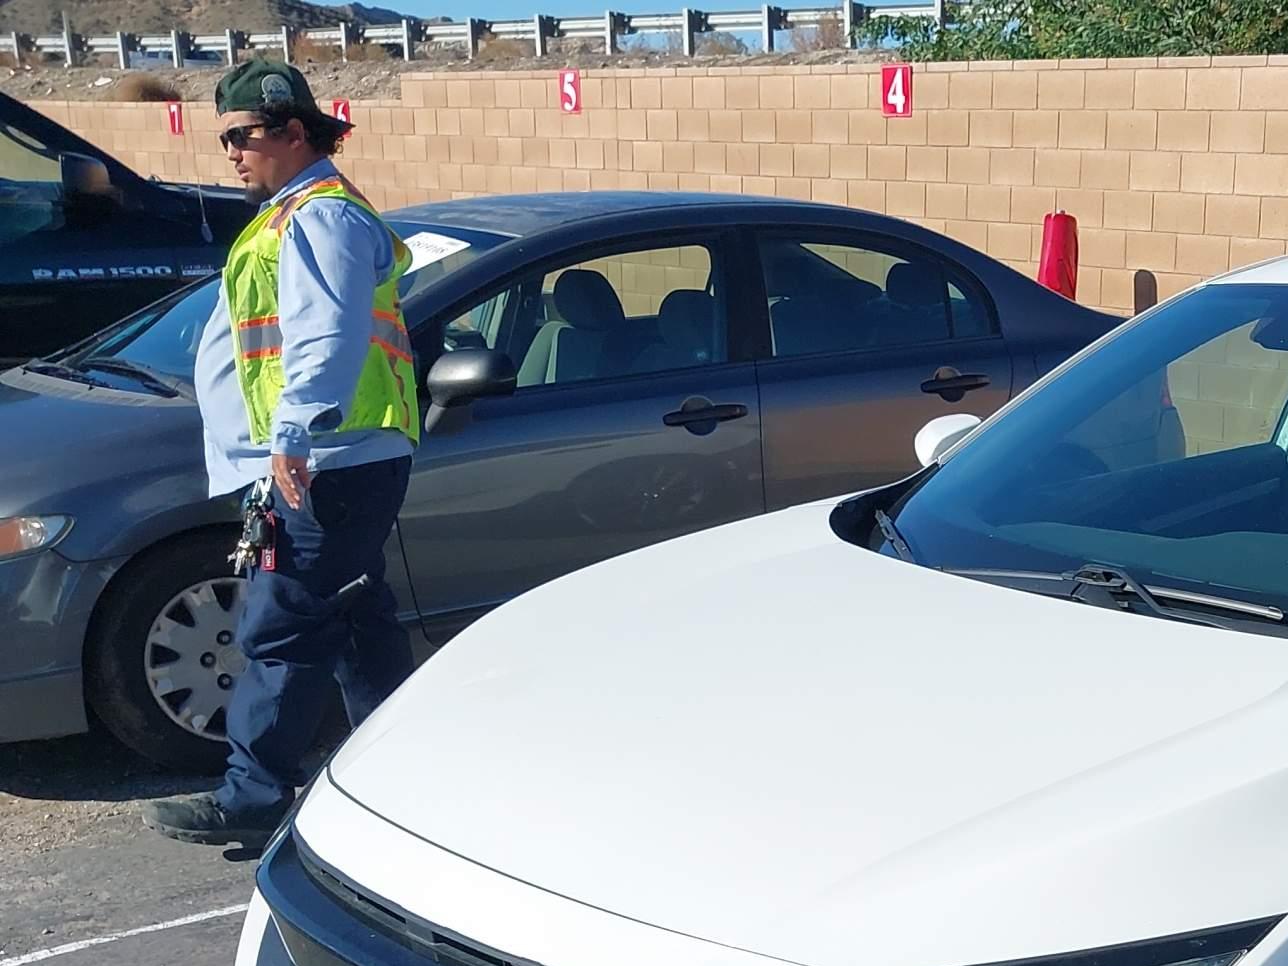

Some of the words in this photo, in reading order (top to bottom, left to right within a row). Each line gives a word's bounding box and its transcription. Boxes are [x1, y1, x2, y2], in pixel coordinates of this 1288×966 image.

[563, 72, 577, 111] 5
[887, 68, 906, 113] 4
[31, 268, 105, 280] RAM
[109, 265, 172, 278] 1500
